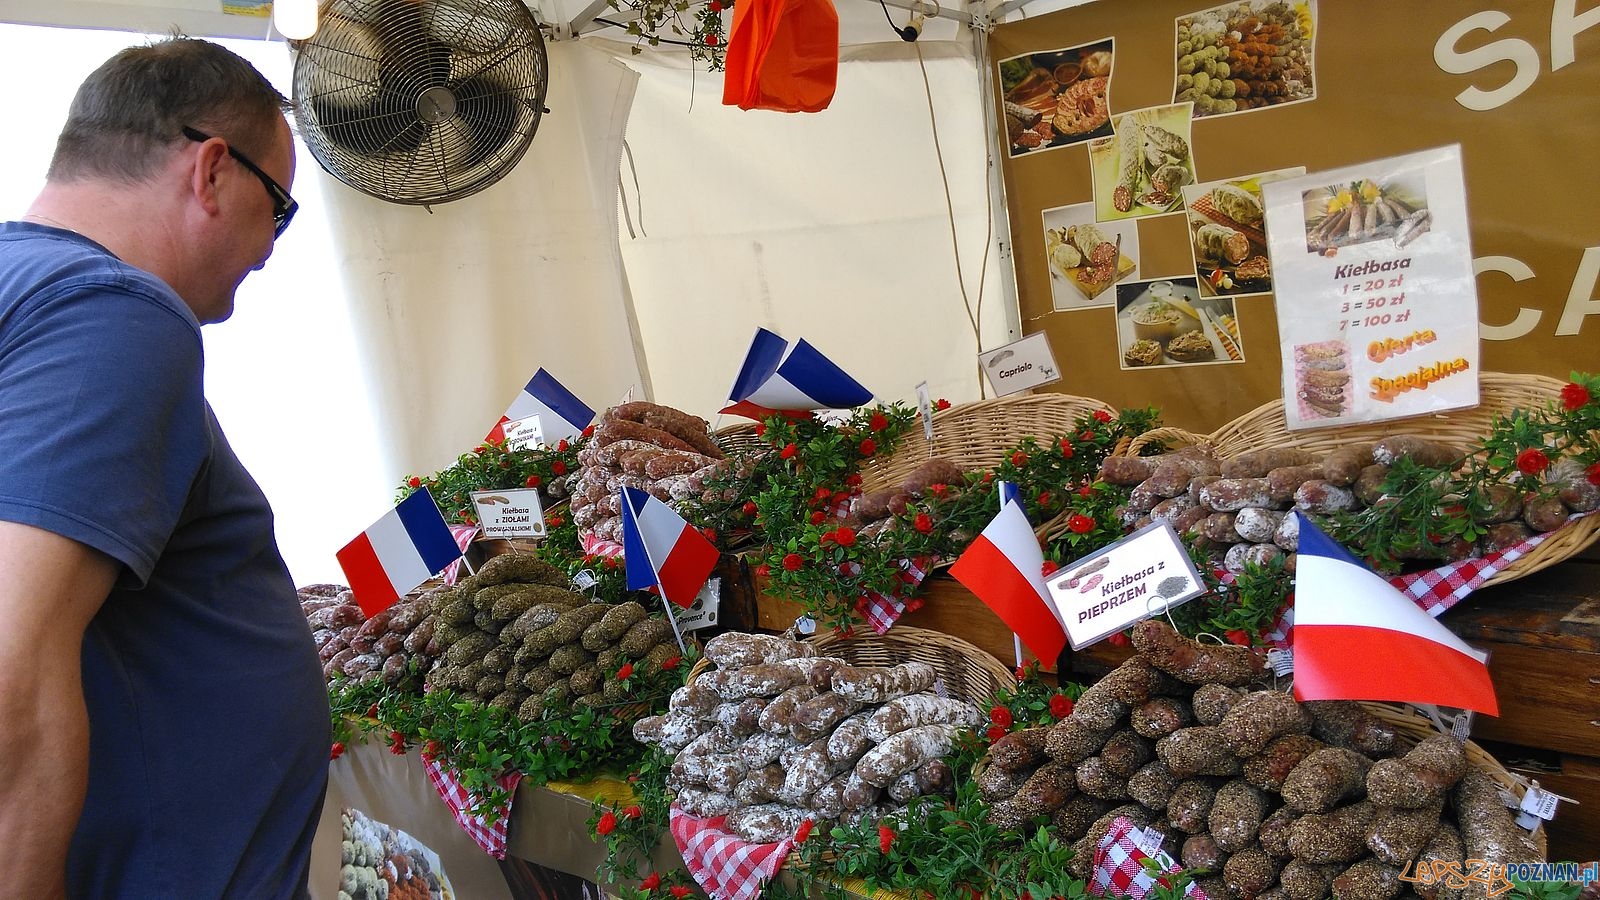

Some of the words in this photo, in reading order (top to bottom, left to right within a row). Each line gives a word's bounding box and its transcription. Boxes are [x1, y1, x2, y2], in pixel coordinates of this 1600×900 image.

[1334, 258, 1412, 279] Kiełbasa
[1342, 284, 1349, 294] 1
[1364, 279, 1385, 292] 20
[1388, 274, 1404, 288] zł
[1341, 302, 1350, 313] 3
[1366, 297, 1386, 309] 50
[1390, 292, 1406, 306] zł
[1339, 320, 1349, 331] 7
[1364, 314, 1392, 327] 100
[1395, 309, 1411, 323] zł
[1367, 328, 1437, 363] Oferta
[999, 362, 1033, 379] Capriolo
[1369, 357, 1470, 403] Specjalna
[502, 507, 530, 515] Kiełbasa
[502, 515, 530, 523] ZIOŁAMI
[1101, 565, 1155, 597] Kiełbasa
[1157, 560, 1166, 571] z
[1078, 582, 1147, 624] PIEPRZEM
